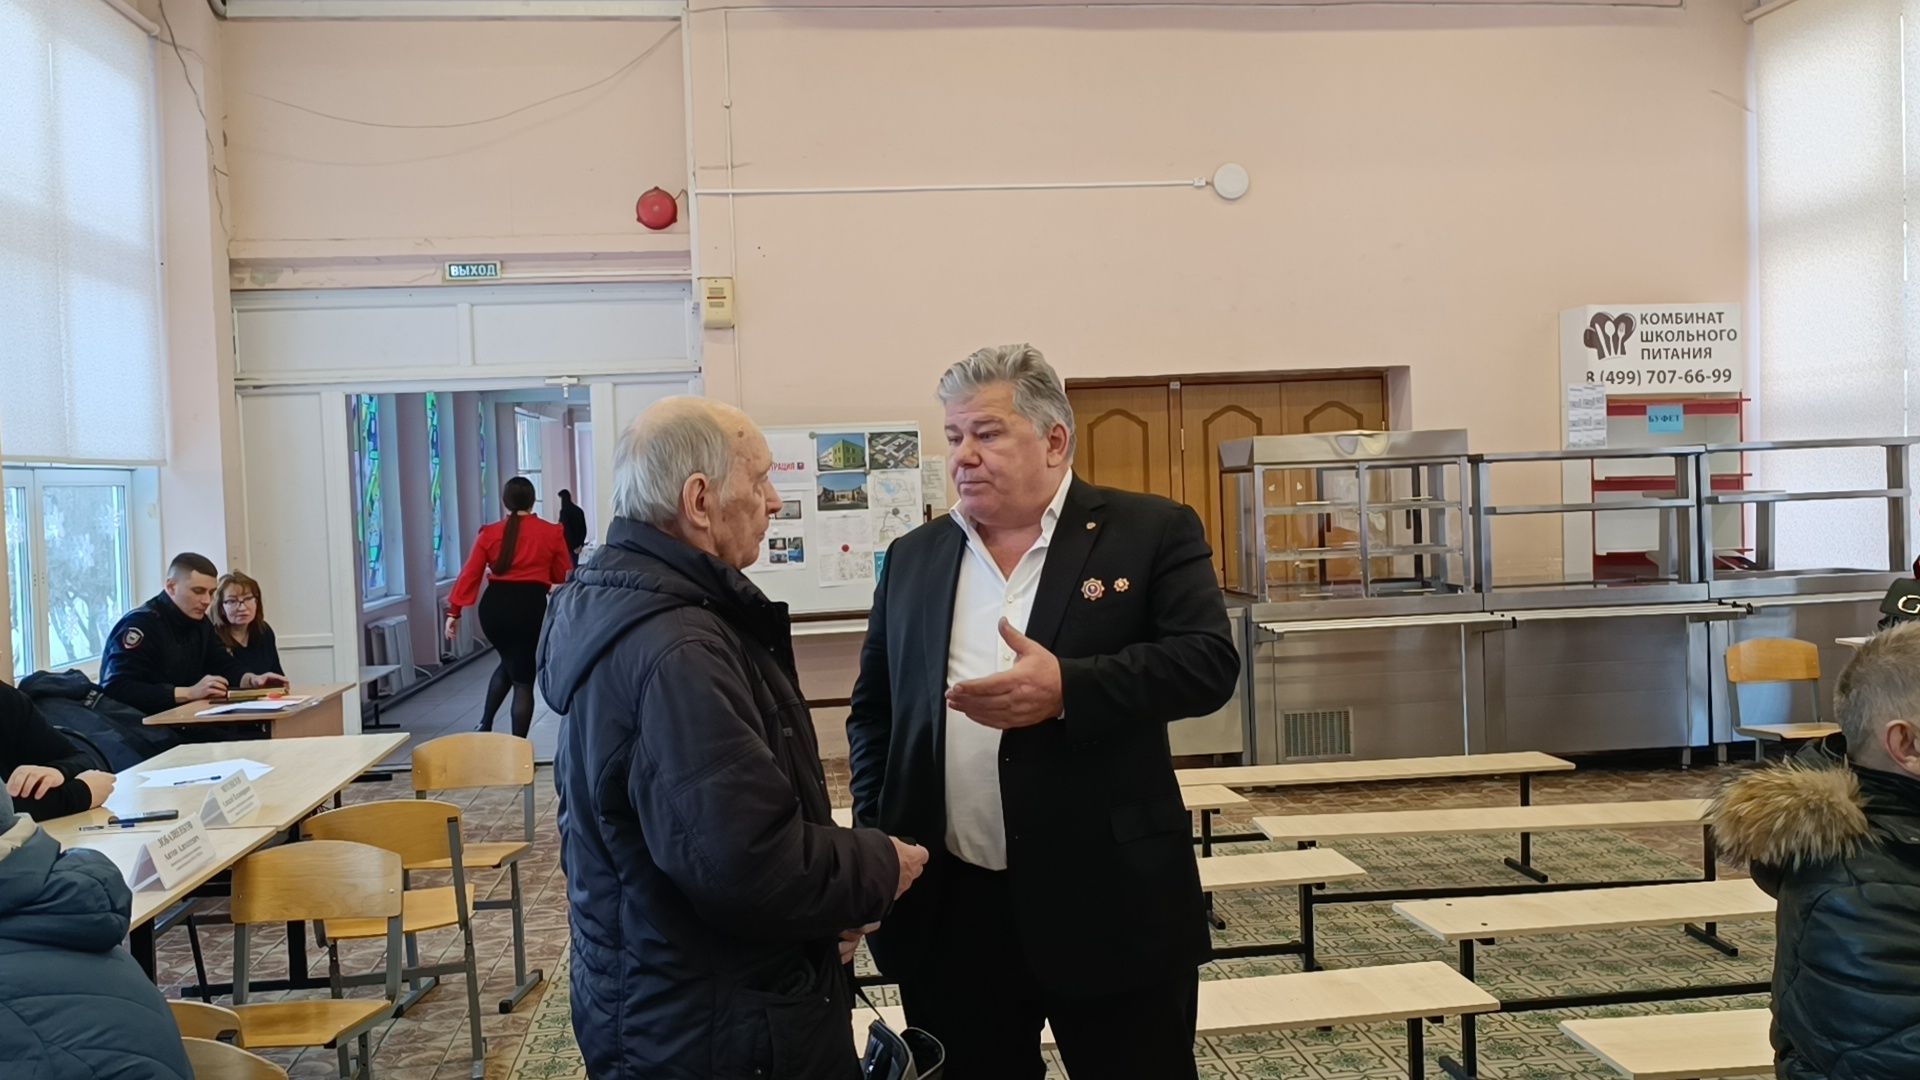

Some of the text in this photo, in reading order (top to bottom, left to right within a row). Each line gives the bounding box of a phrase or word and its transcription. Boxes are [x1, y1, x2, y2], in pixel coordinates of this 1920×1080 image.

[450, 264, 496, 277] ВЫХОД
[1640, 312, 1724, 325] КОМБИНАТ
[1640, 329, 1738, 342] ШКОЛЬНОГО
[1641, 347, 1712, 360] ПИТАНИЯ
[1586, 369, 1732, 386] 8 (499) 707-66-99
[1648, 414, 1680, 423] БУФЕТ
